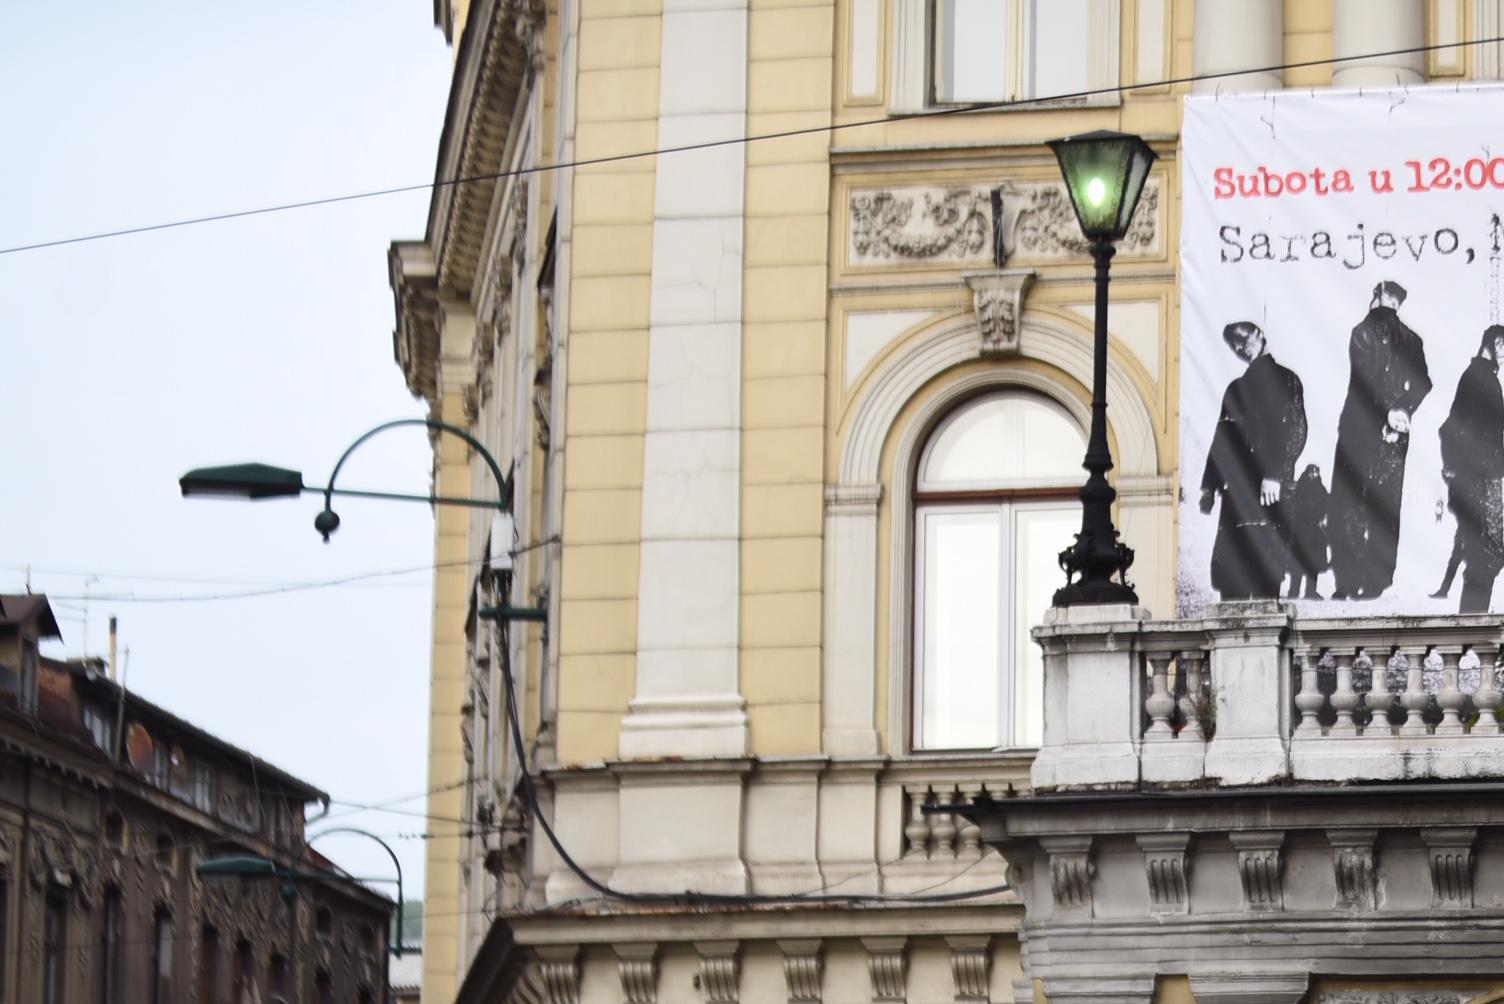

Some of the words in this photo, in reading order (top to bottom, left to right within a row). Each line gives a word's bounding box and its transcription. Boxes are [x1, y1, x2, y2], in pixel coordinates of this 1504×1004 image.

[1213, 166, 1355, 200] Subota
[1368, 169, 1395, 193] u
[1219, 223, 1477, 270] Sarajevo,
